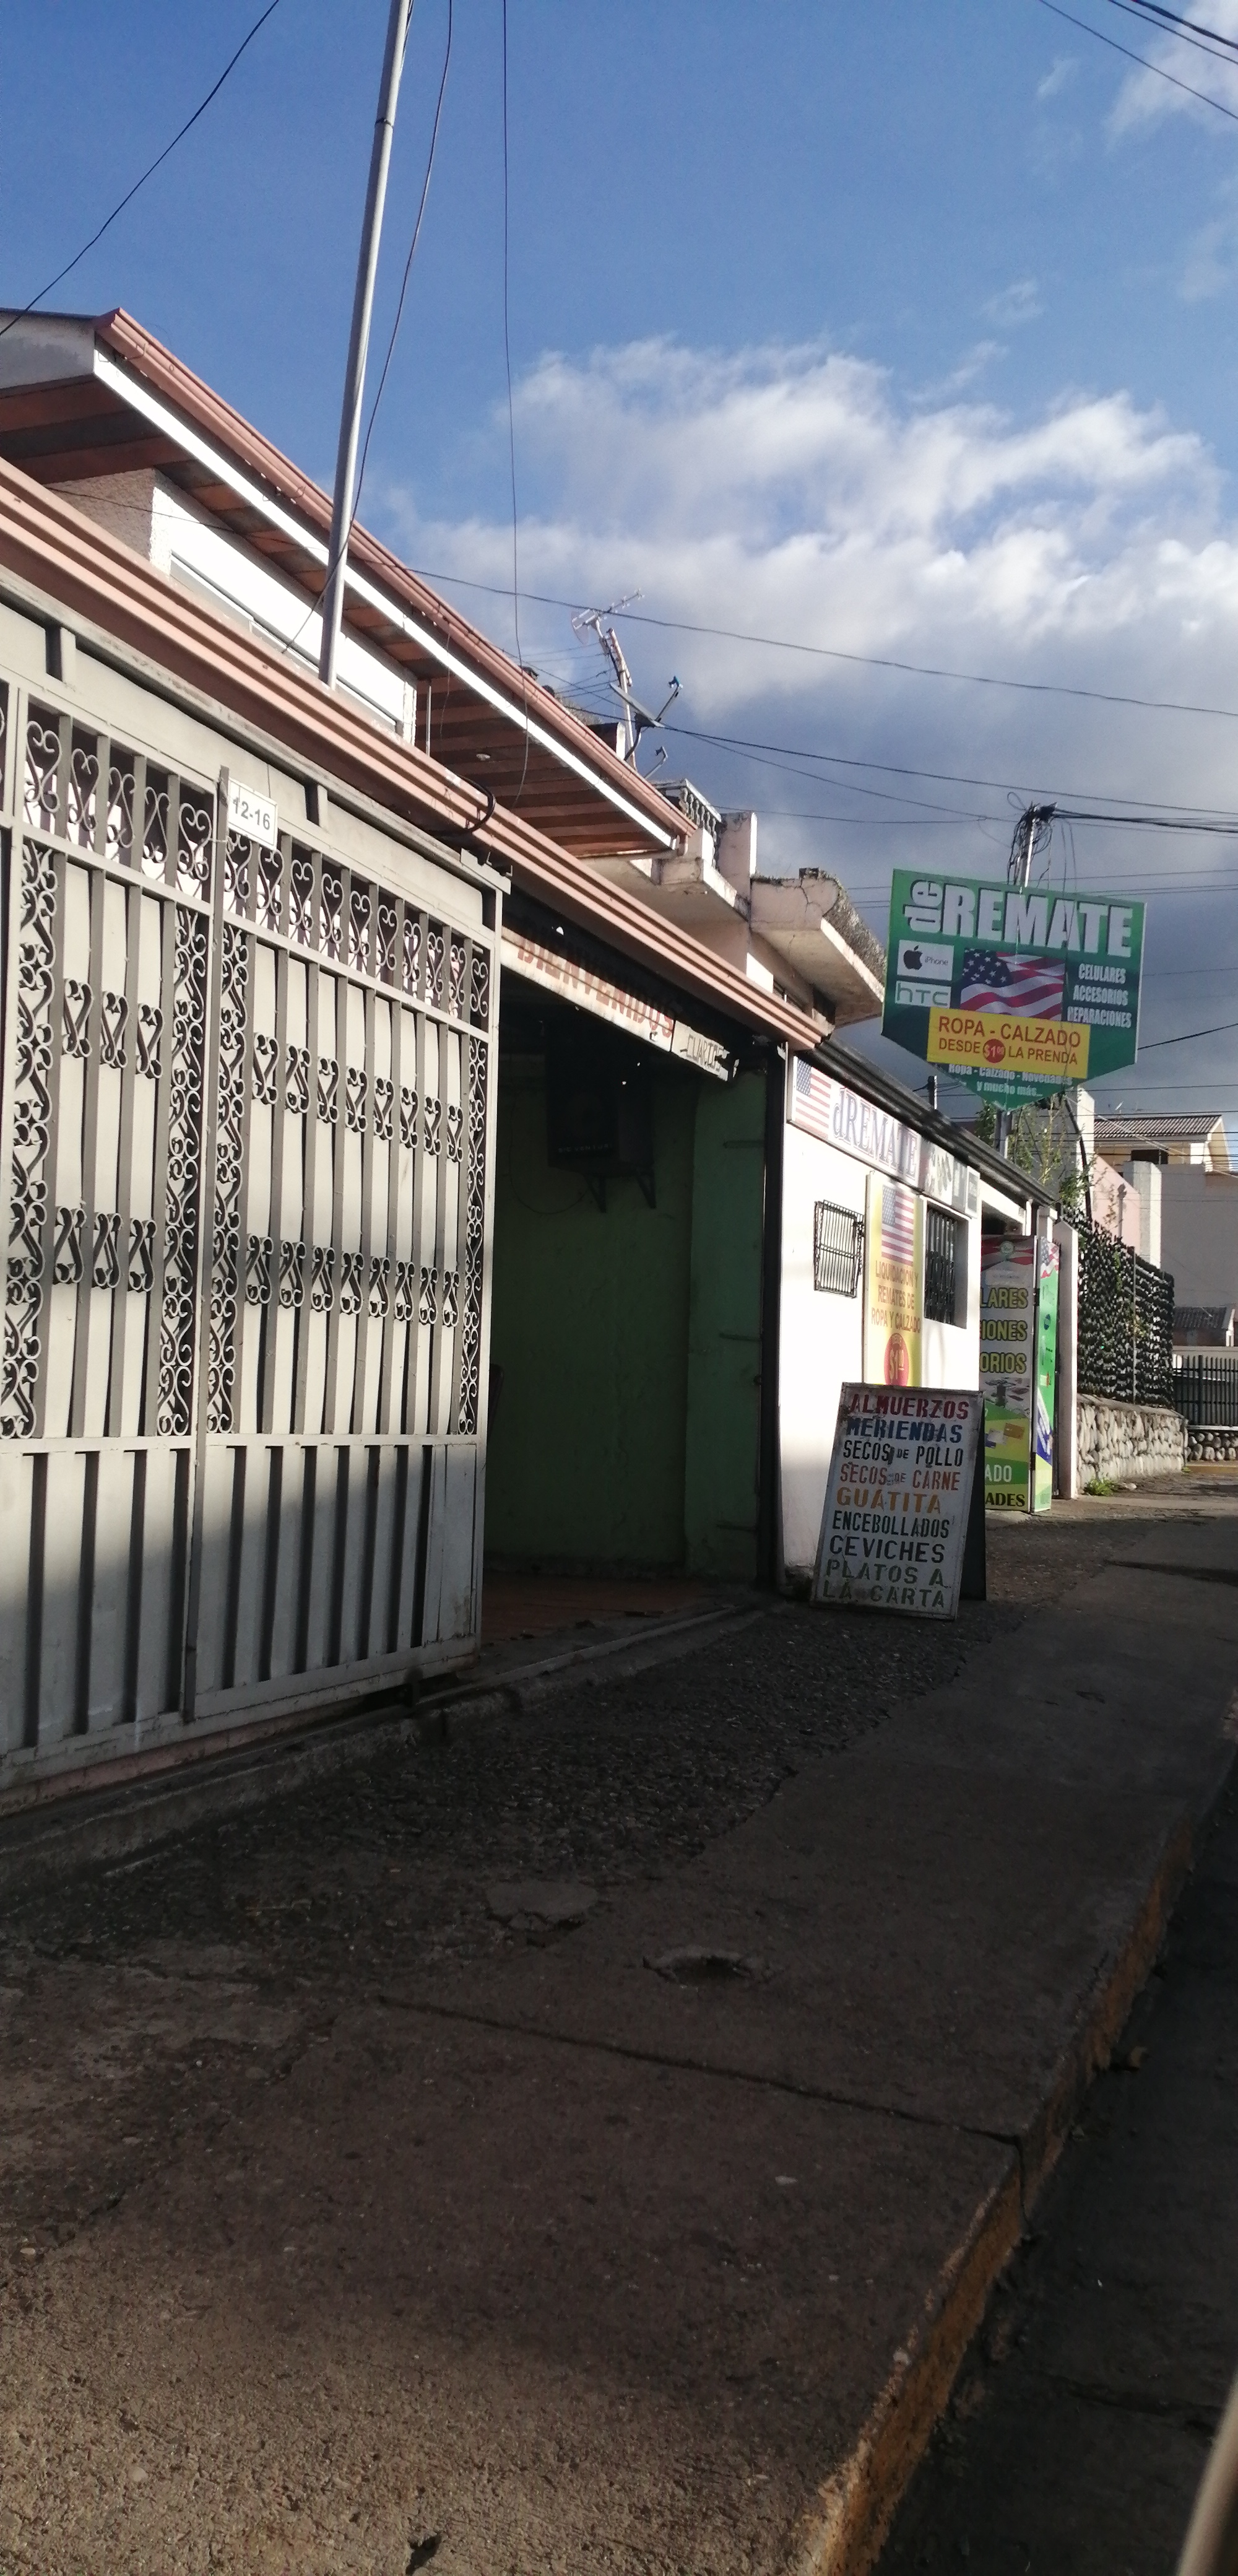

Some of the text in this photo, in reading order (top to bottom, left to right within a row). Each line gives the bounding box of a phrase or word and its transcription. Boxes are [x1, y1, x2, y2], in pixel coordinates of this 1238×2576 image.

[233, 797, 270, 830] 12-16
[903, 879, 1133, 957] de REMATE
[925, 955, 948, 966] iPhone
[1078, 963, 1126, 984] CELULARES
[1073, 985, 1128, 1006] ACCESORIOS
[1067, 1006, 1132, 1029] REPARACIONES
[938, 1016, 985, 1037] ROPA
[1000, 1023, 1081, 1048] CALZADO
[939, 1037, 981, 1054] DESDE
[1008, 1045, 1024, 1058] LA
[1028, 1048, 1078, 1065] PRENDA
[948, 1064, 972, 1075] Ropa
[984, 1082, 1015, 1094] mucho
[878, 1284, 915, 1310] REMATES DE
[871, 1307, 921, 1333] ROPA Y CALZADO
[850, 1393, 969, 1420] ALMUERZOS
[847, 1416, 962, 1443] MERIENDAS
[842, 1440, 964, 1467] SECOS DE POLLO
[840, 1464, 887, 1486] SECOS
[912, 1469, 961, 1491] CARNE
[836, 1486, 941, 1514] GUATITA
[832, 1510, 950, 1538] ENCEBOLLADOS
[829, 1534, 945, 1564] CEVICHES
[825, 1559, 945, 1586] PLATOS A
[822, 1580, 945, 1608] LA CARTA
